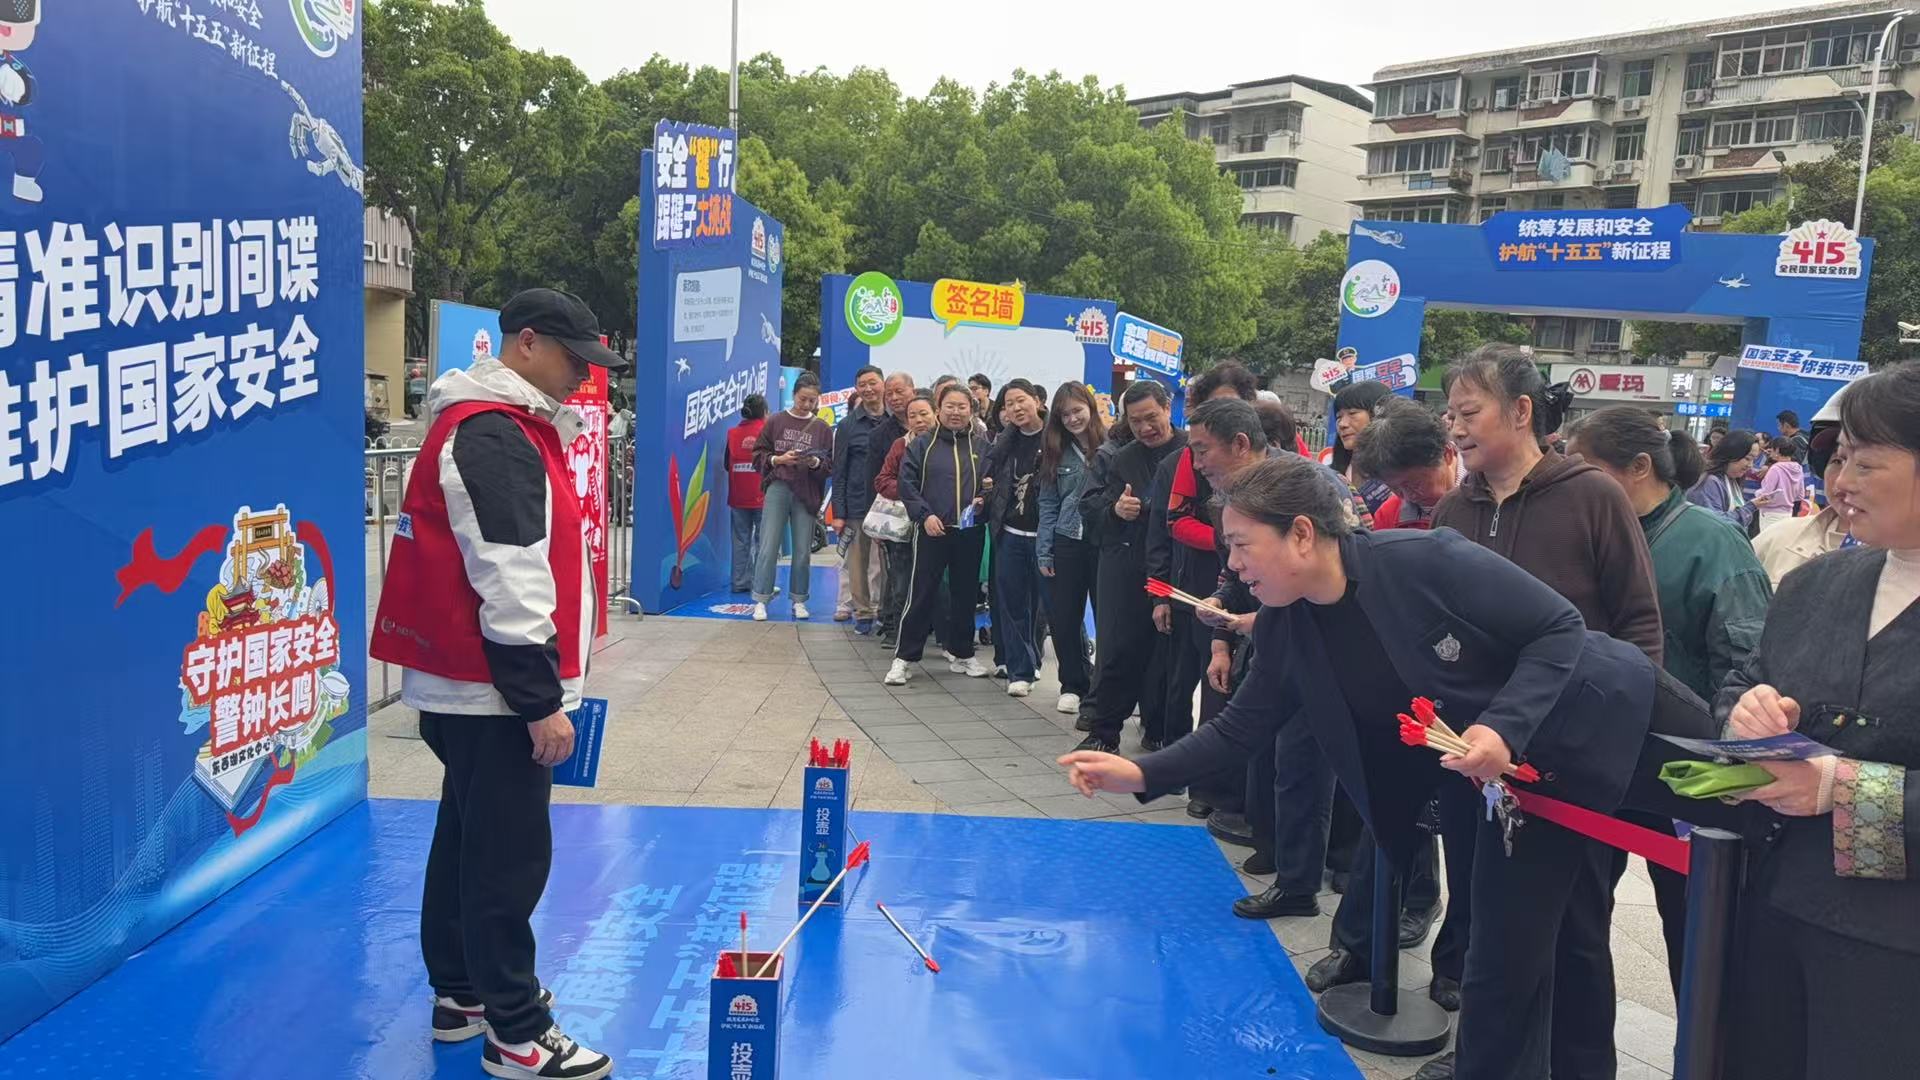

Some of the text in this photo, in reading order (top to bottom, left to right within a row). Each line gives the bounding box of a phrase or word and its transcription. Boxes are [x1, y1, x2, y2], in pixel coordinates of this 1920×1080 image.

[1518, 216, 1653, 238] 统筹发展和安全
[1499, 240, 1671, 262] 护航“十五五”新征程
[1791, 241, 1847, 265] 415
[1779, 264, 1857, 276] 全民国家安全教育
[0, 216, 319, 348] 准识别间谍
[946, 283, 1015, 321] 签名墙
[1080, 320, 1104, 337] 415
[1745, 347, 1805, 364] 国家安全
[1321, 366, 1341, 380] 415
[1800, 359, 1865, 376] 你我守护
[1599, 373, 1645, 392] 爱玛
[684, 361, 768, 440] 国家安全记心间
[186, 616, 336, 697] 守护国家安全
[213, 671, 312, 749] 警钟长鸣
[816, 807, 830, 836] 投壶
[734, 1002, 753, 1011] 415
